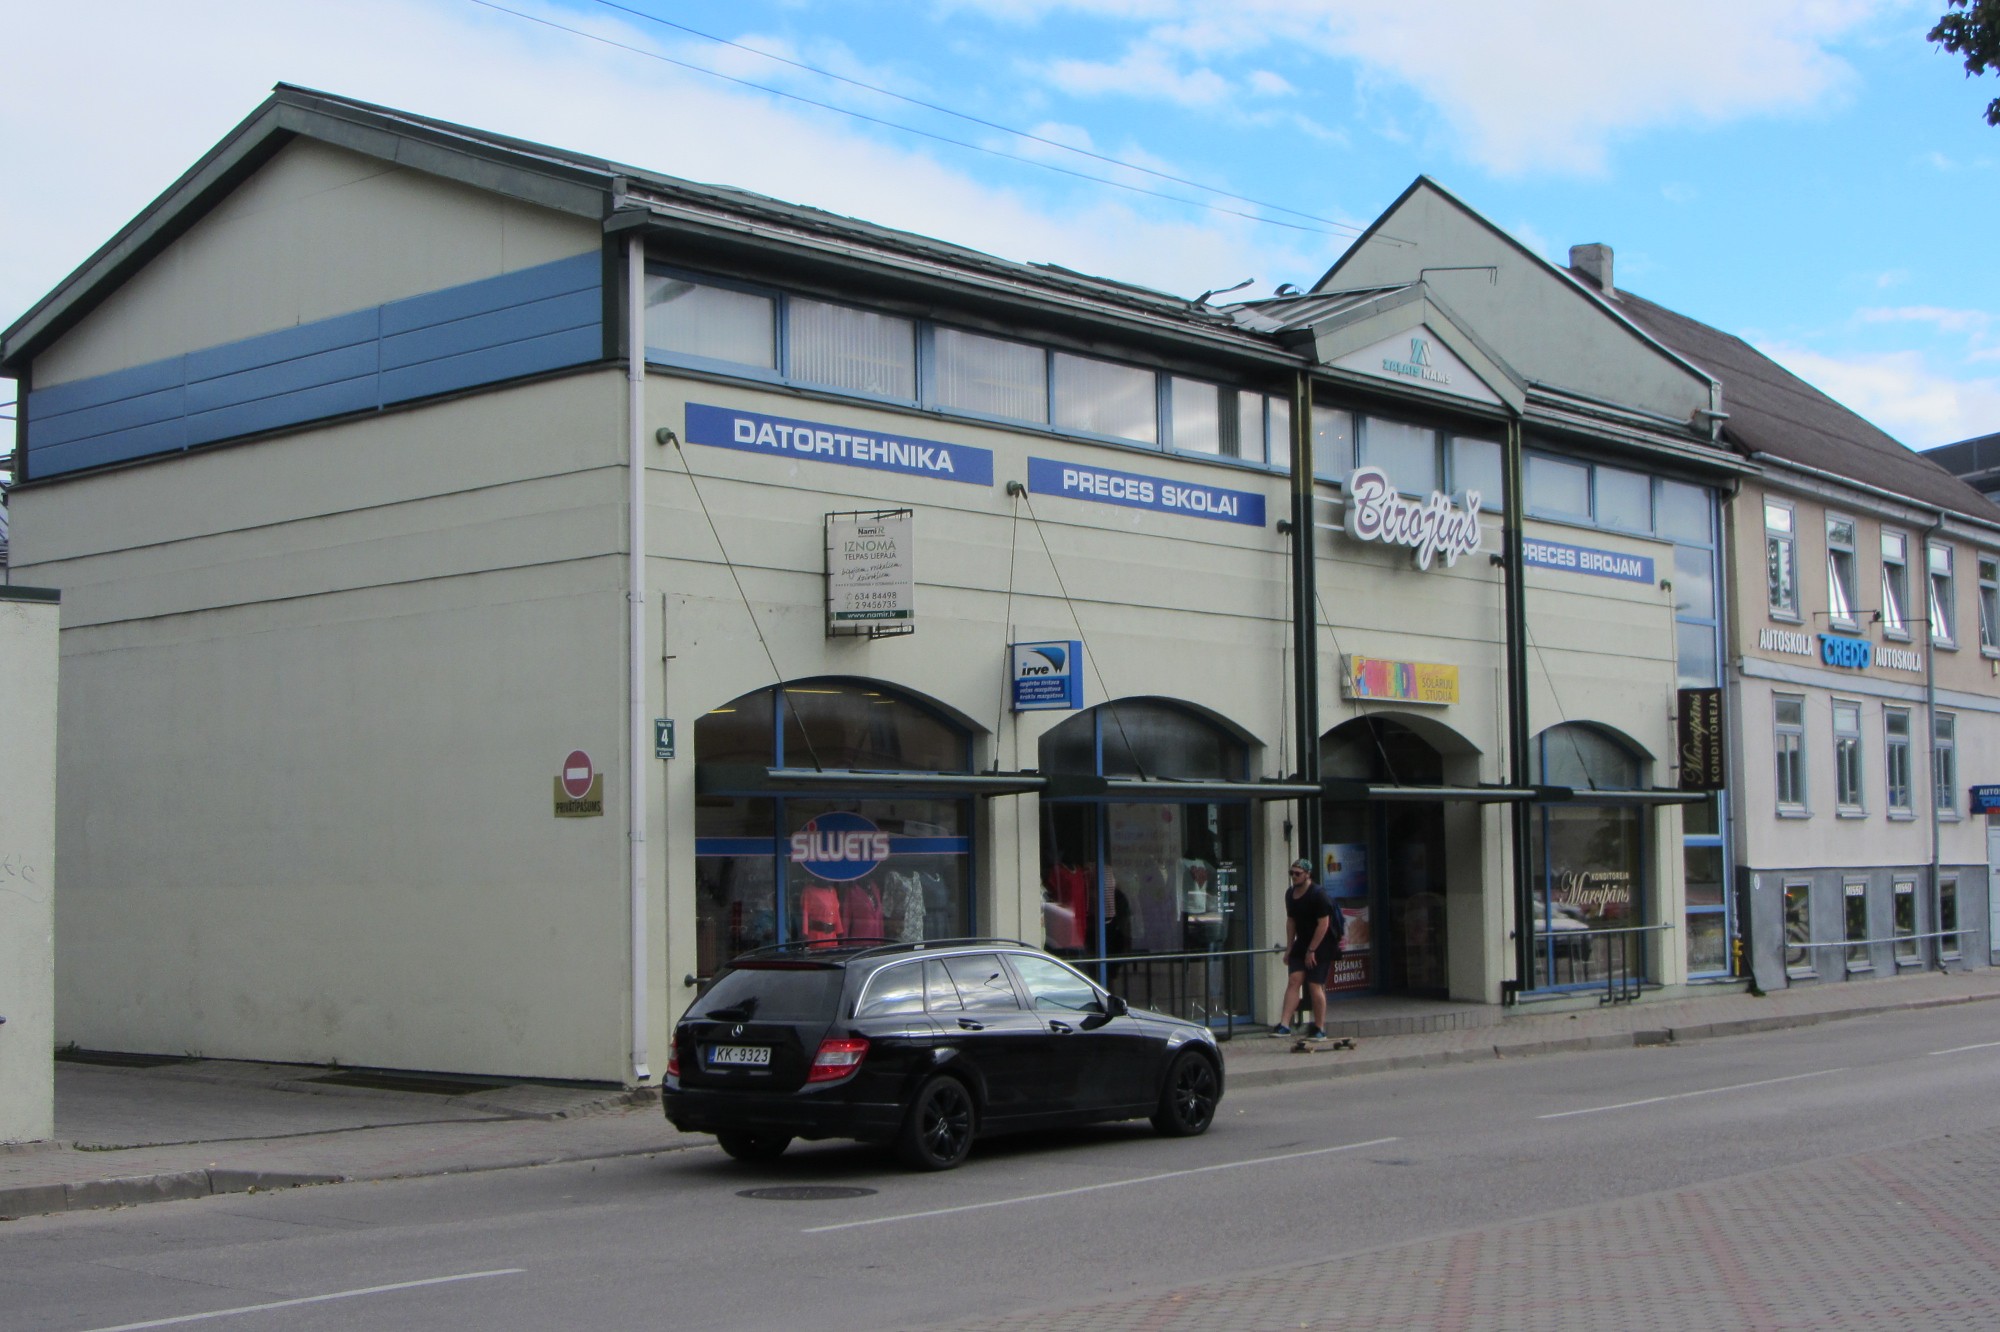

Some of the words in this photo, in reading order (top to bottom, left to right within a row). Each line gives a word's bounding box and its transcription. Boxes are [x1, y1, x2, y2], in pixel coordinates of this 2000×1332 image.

[733, 418, 954, 473] DATORTEHNIKA
[1063, 469, 1154, 502] PRECES
[1161, 486, 1237, 516] SKOLAI
[844, 538, 897, 552] IZNOMĀ
[845, 552, 869, 561] TELPAS
[1580, 552, 1641, 577] BIROJAM
[855, 592, 869, 600] 634
[872, 592, 897, 600] 84498
[1759, 628, 1814, 657] AUTOSKOLA
[1818, 634, 1871, 669] CREDO
[1875, 647, 1922, 672] AUTOSKOLA
[1021, 663, 1049, 676] irve
[661, 729, 669, 745] 4
[1709, 693, 1721, 783] KONDITOREJA
[1591, 872, 1630, 881] KONDITOREJA
[1559, 871, 1630, 917] Marcipāns
[716, 1047, 769, 1062] KK-9323
